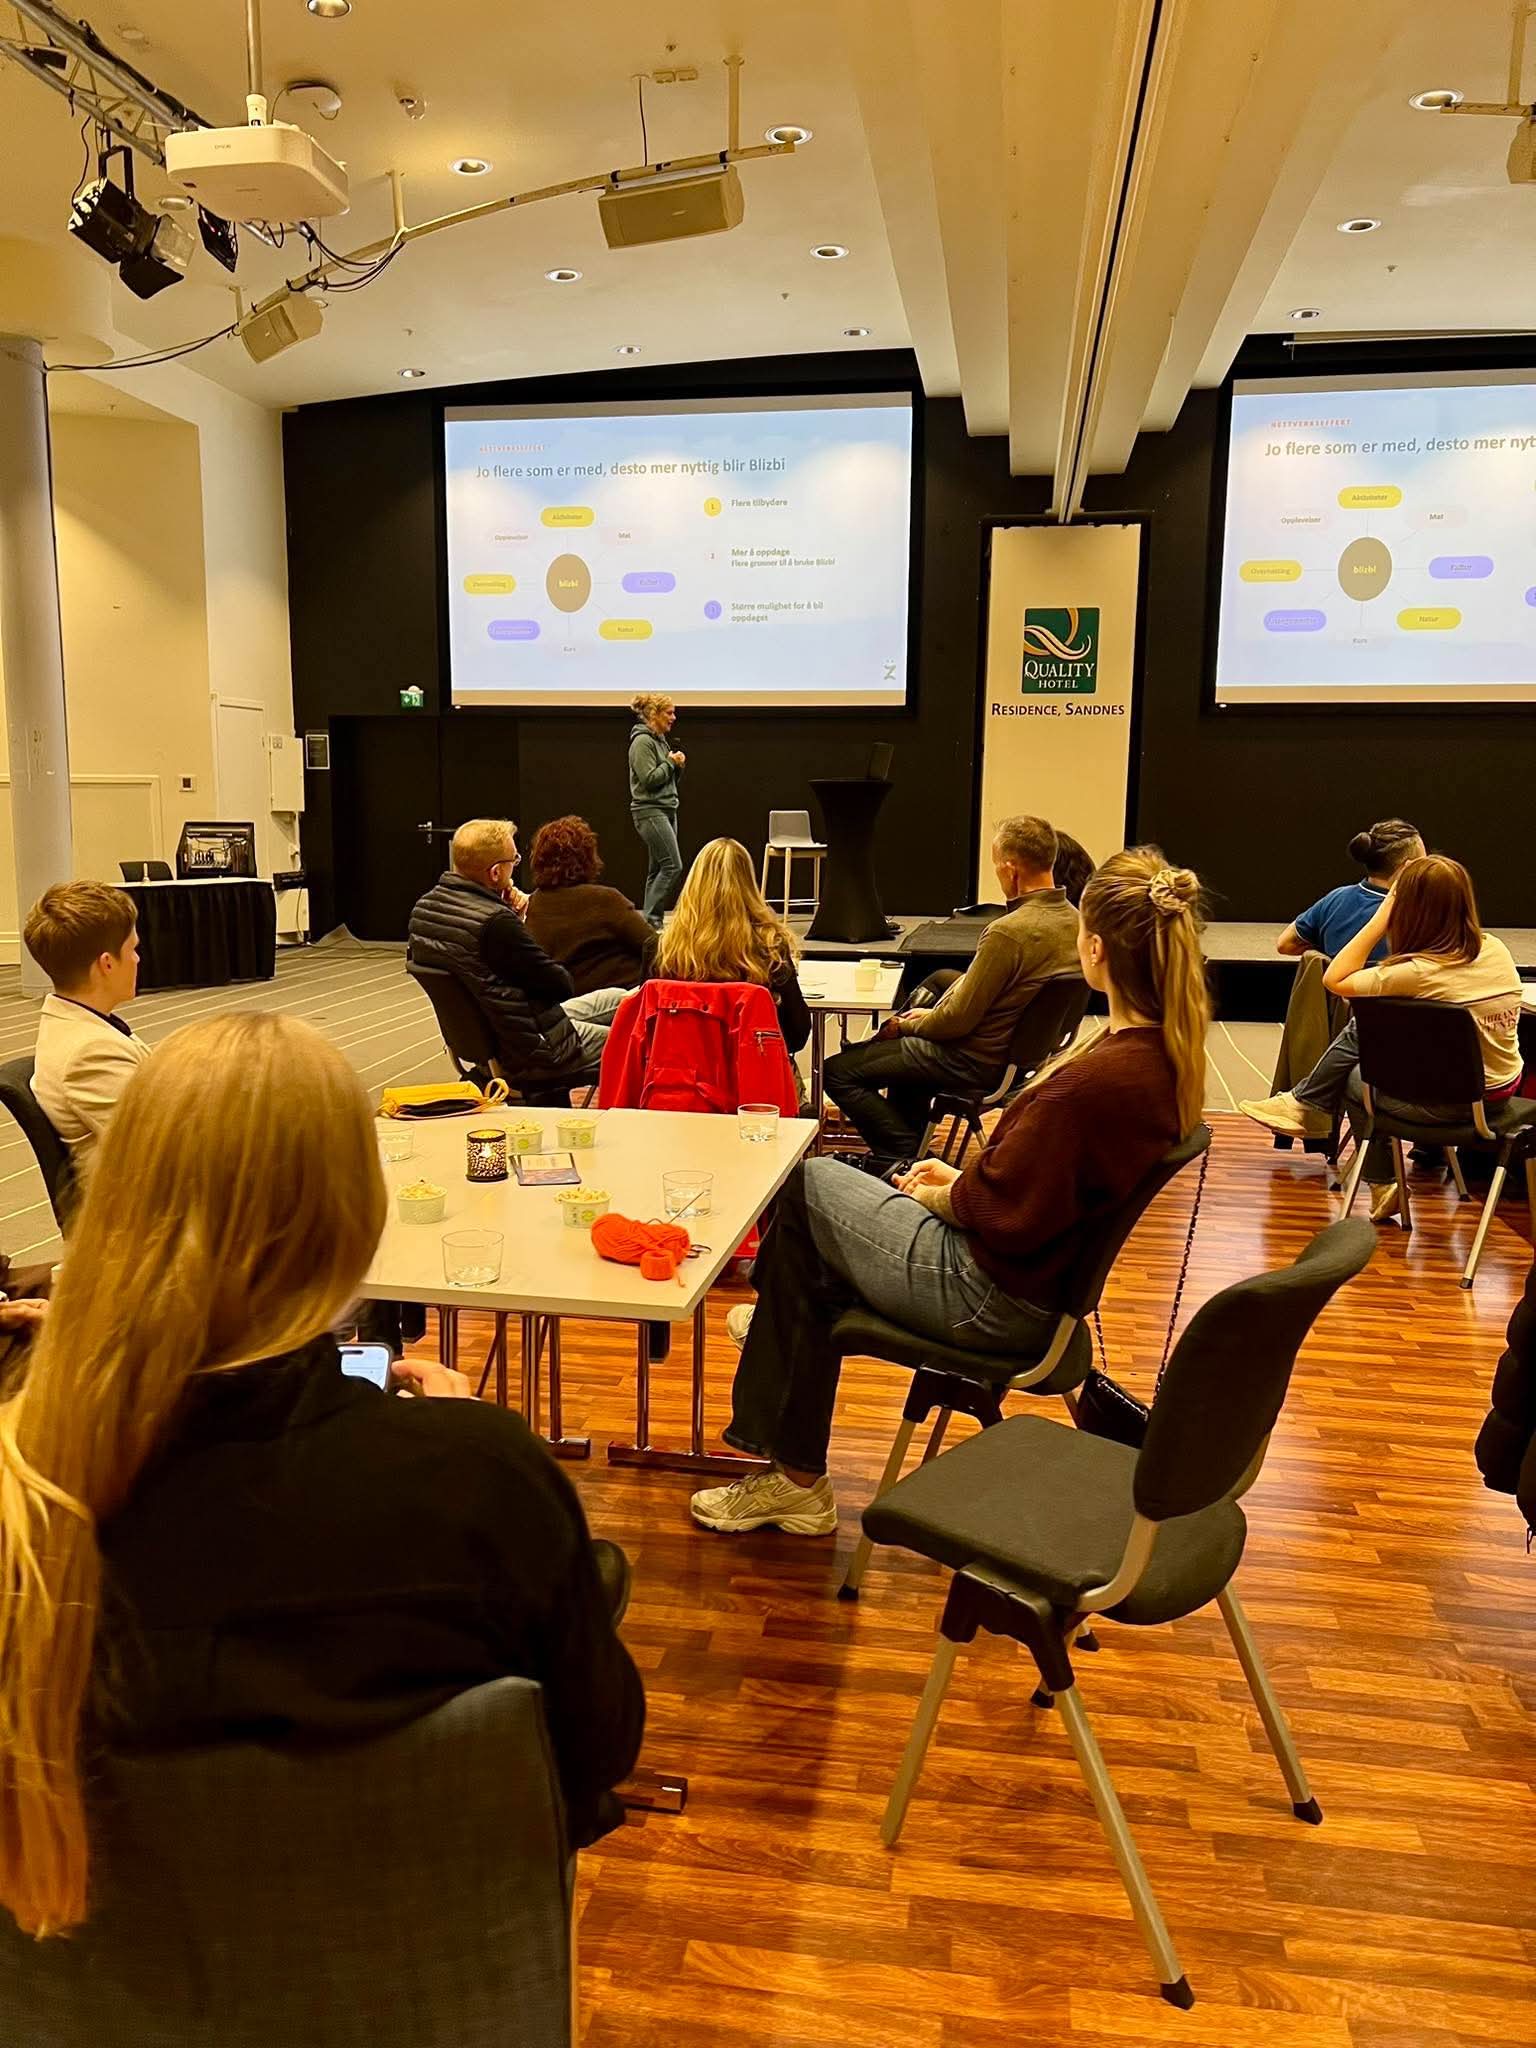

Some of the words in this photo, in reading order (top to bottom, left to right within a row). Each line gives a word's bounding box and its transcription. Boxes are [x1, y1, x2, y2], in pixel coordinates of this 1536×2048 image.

[1265, 443, 1281, 456] Jo
[1286, 441, 1320, 456] flere
[1325, 443, 1357, 454] som
[1362, 442, 1378, 453] er
[1382, 438, 1421, 454] med,
[1426, 438, 1470, 450] desto
[1474, 438, 1506, 449] mer
[476, 466, 490, 478] Jo
[494, 464, 522, 477] flere
[527, 467, 552, 477] som
[557, 466, 570, 476] er
[574, 462, 607, 478] med,
[610, 462, 647, 475] desto
[650, 463, 677, 474] mer
[681, 460, 719, 476] nyttig
[723, 459, 746, 472] blir
[750, 458, 785, 472] Blizbi
[756, 548, 790, 558] oppdage
[757, 602, 792, 612] mulighet
[1024, 660, 1095, 680] QUALITY
[1038, 679, 1078, 689] HOTEL
[991, 703, 1061, 716] RESIDENCE,
[1065, 702, 1124, 716] SANDNES
